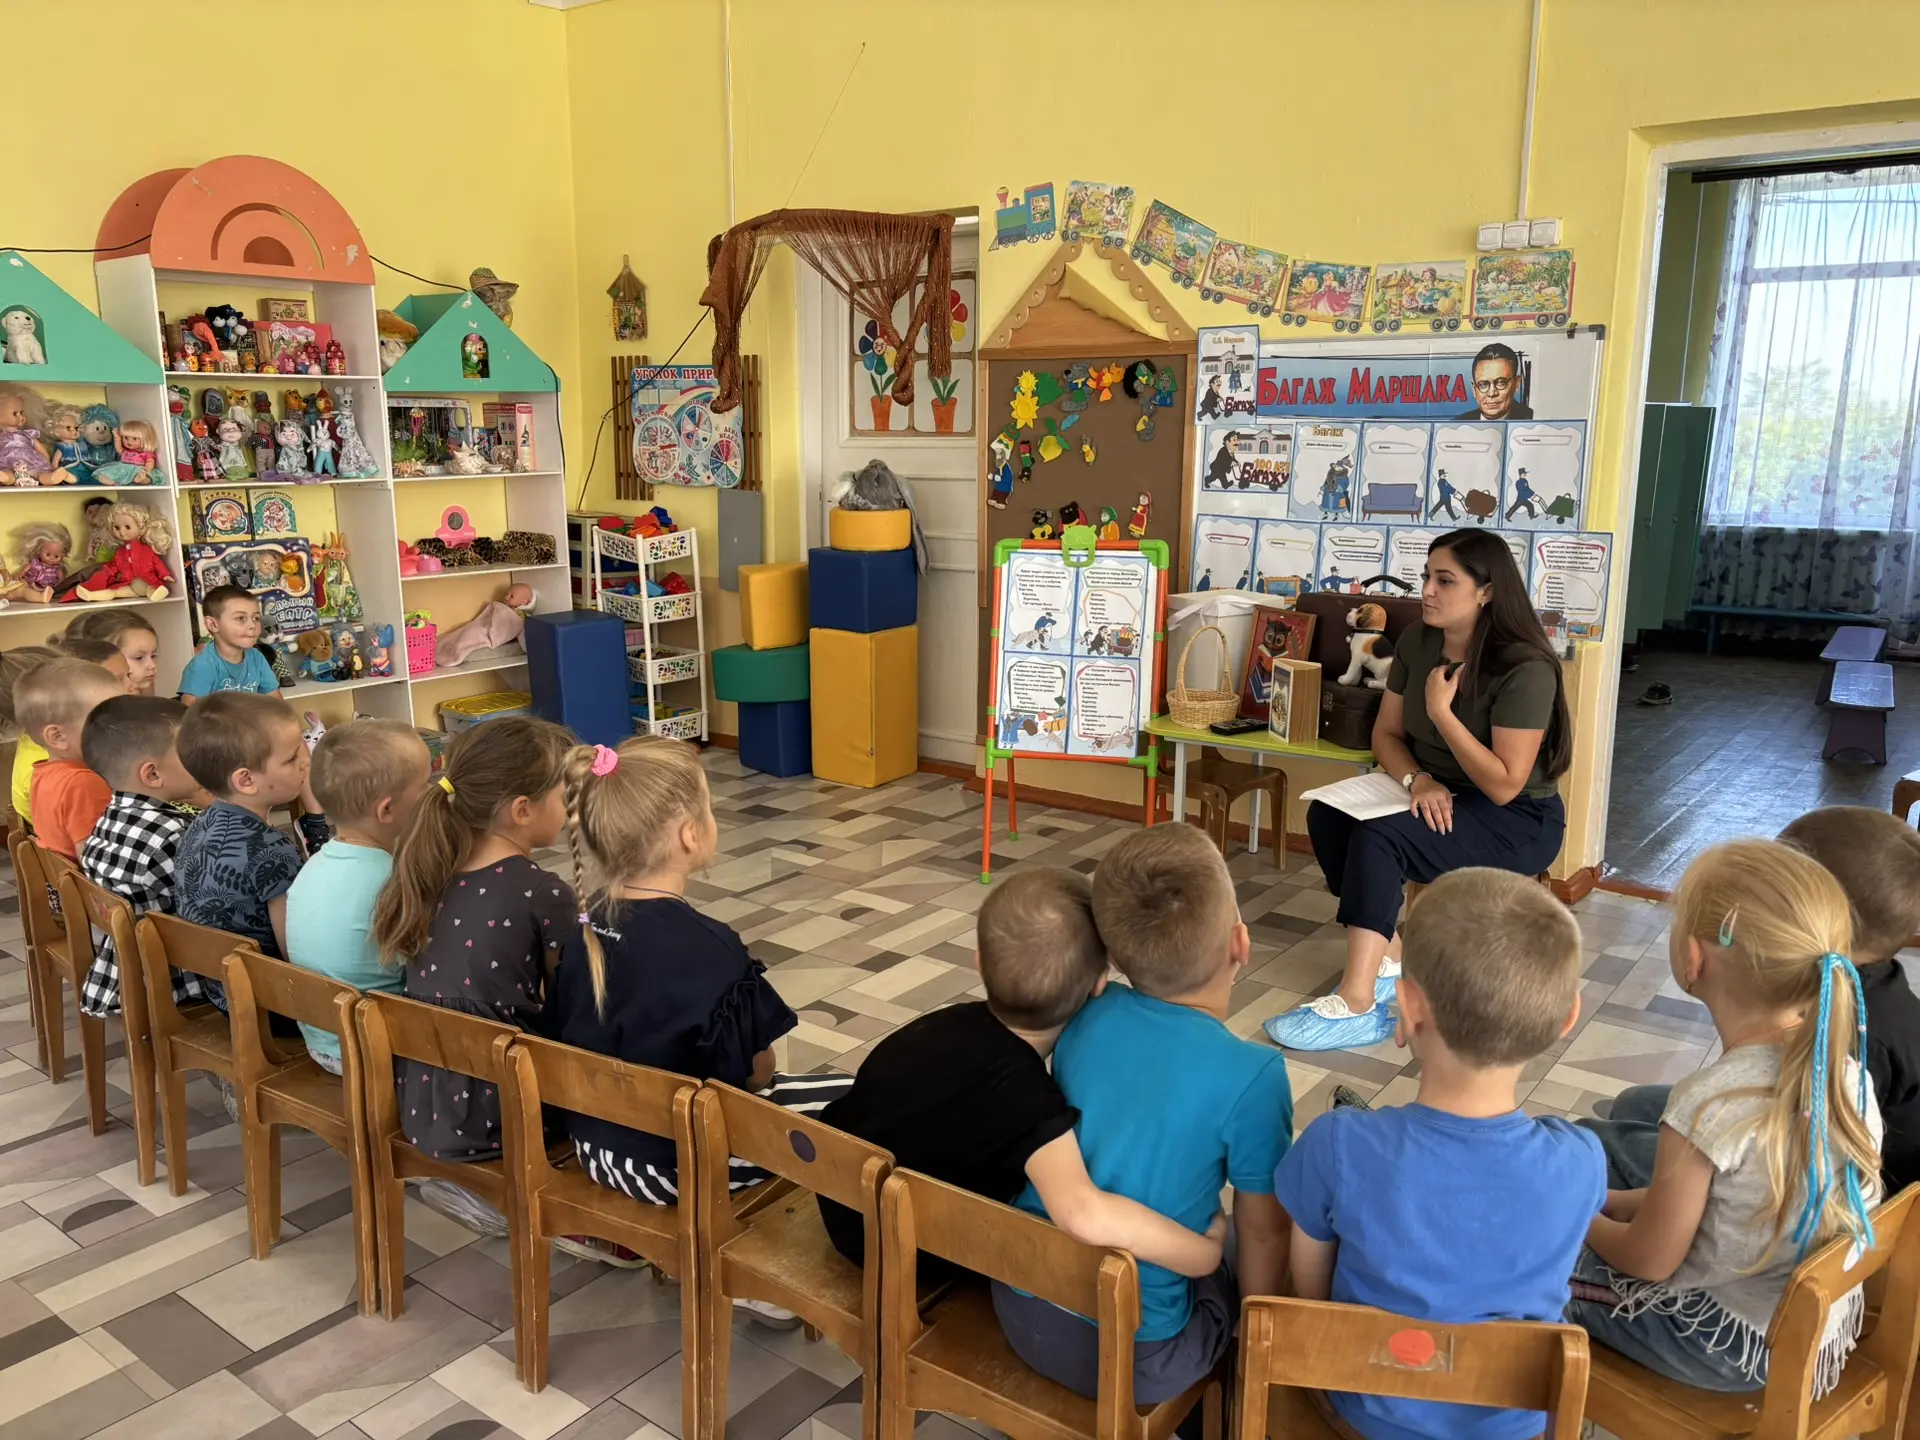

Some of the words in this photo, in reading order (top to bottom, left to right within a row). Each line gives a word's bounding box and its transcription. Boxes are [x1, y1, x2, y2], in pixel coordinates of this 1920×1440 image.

[682, 368, 714, 380] ПРИР
[1258, 367, 1337, 406] БАГАЖ
[1346, 367, 1468, 405] МАРШАКА
[1224, 396, 1256, 413] БАГАЖ
[1241, 461, 1290, 487] БАГАЖУ
[276, 607, 313, 622] ЕАТР
